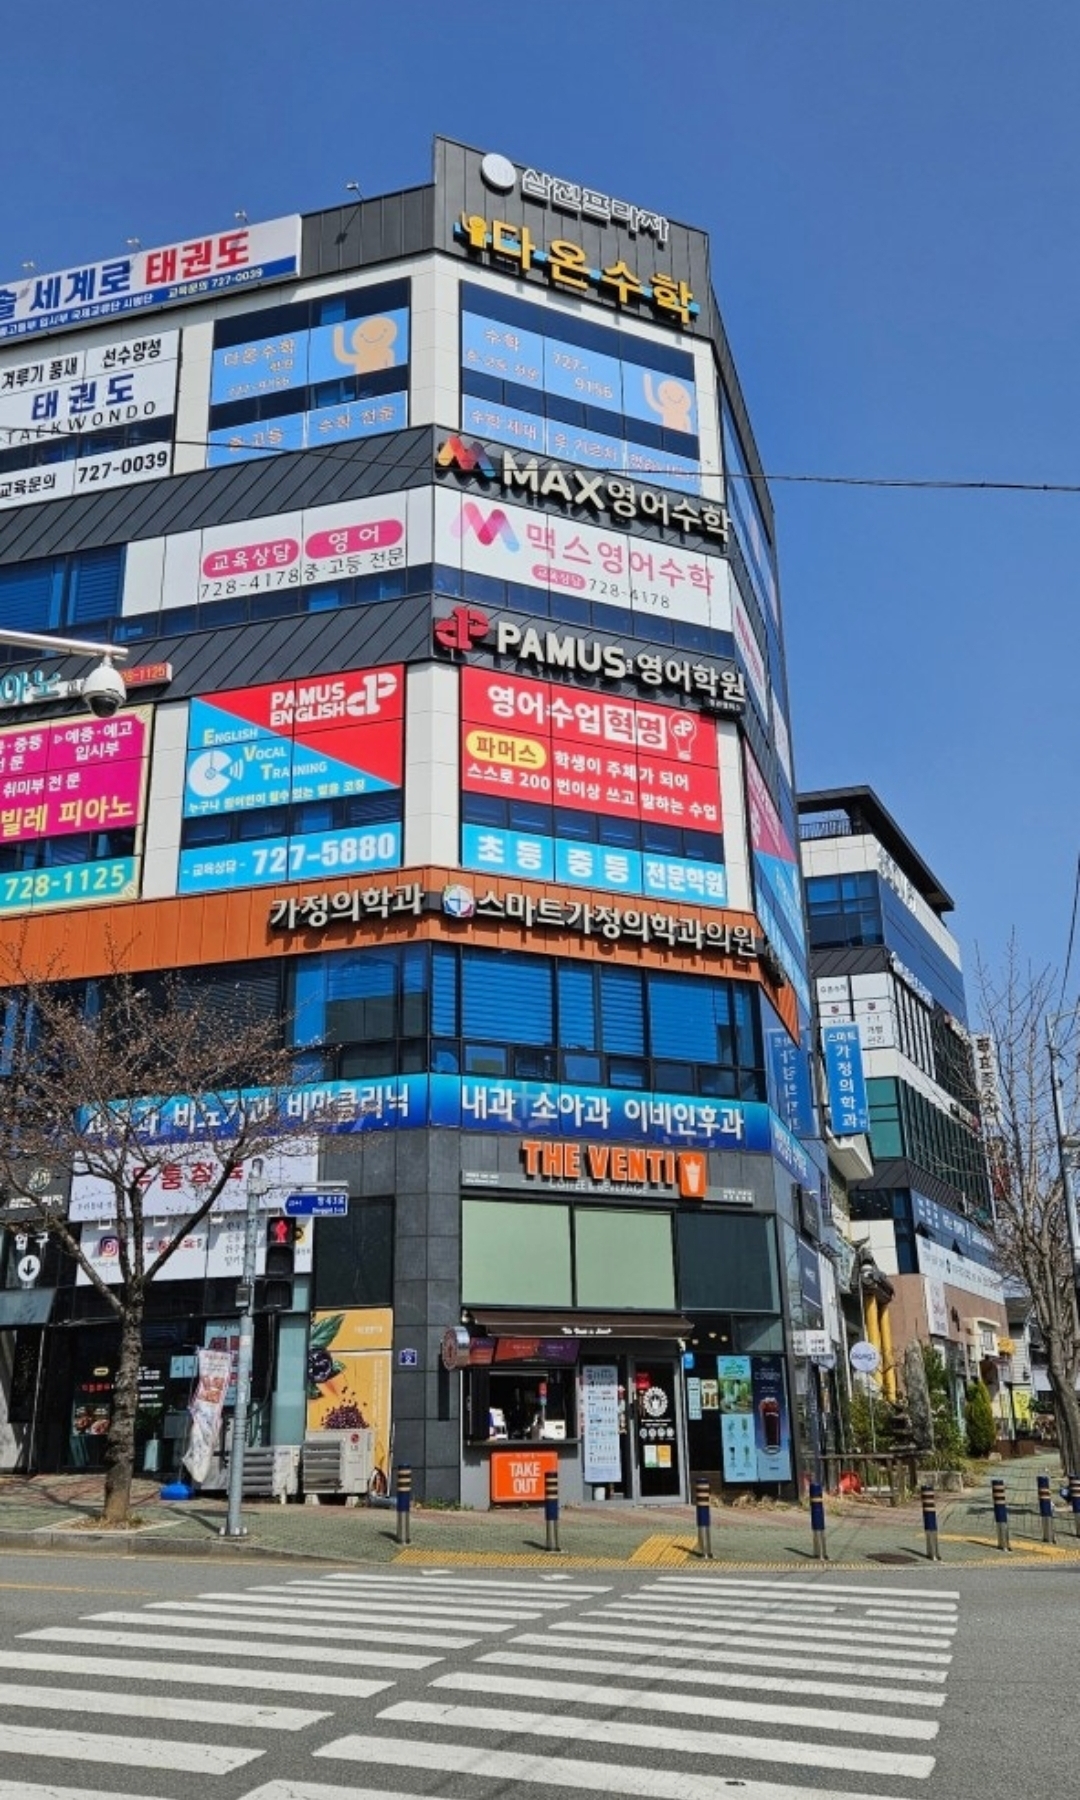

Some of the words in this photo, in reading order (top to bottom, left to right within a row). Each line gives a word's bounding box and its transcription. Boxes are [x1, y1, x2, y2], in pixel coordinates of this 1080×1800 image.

[29, 260, 131, 312] 세계로
[145, 231, 249, 285] 태권도
[211, 267, 263, 288] 727-0039
[492, 219, 694, 325] 다온수학
[49, 357, 78, 380] 품새
[103, 338, 162, 369] 선수양성
[32, 374, 134, 420] 태권도
[5, 401, 156, 445] TAEKWONDO
[0, 473, 57, 498] 교육문의
[78, 450, 168, 483] 727-0039
[328, 525, 380, 554] 영어
[212, 543, 291, 572] 교육상담
[370, 547, 404, 569] 전문
[526, 523, 715, 597] 맥스영어수학
[201, 568, 299, 598] 728-4178
[589, 578, 670, 609] 728-4178
[496, 621, 627, 679] PAMUS
[636, 653, 745, 702] 영어학원
[271, 681, 345, 710] PAMUS
[269, 702, 345, 727] ENGLISH
[76, 741, 120, 762] 입시부
[203, 728, 258, 746] ENGLISH
[242, 744, 288, 762] VOCAL
[260, 761, 328, 781] TRAINING
[476, 735, 537, 764] 파머스
[554, 750, 601, 775] 학생이
[659, 770, 689, 792] 되어
[3, 776, 44, 799] 취미부
[467, 763, 514, 785] 스스로
[519, 771, 552, 791] 200
[606, 786, 637, 804] 쓰고
[640, 792, 685, 817] 말하는
[689, 801, 717, 822] 수업
[58, 795, 134, 828] 피아노
[252, 832, 395, 875] 727-5880
[478, 834, 543, 871] 초등
[567, 847, 630, 884] 중등
[645, 859, 725, 898] 전문학원
[5, 864, 125, 902] 728-1125
[270, 883, 425, 929] 가정의학과
[476, 889, 758, 958] 스마트가정의학과의원
[836, 1044, 857, 1128] 가정의학과
[461, 1084, 515, 1122] 내과
[531, 1091, 611, 1130] 소아과
[624, 1098, 744, 1140] 이비인후과
[522, 1139, 581, 1179] THE
[587, 1144, 676, 1185] VENTI
[14, 1231, 50, 1251] 입구
[508, 1461, 541, 1478] TAKE
[513, 1478, 537, 1494] OUT
